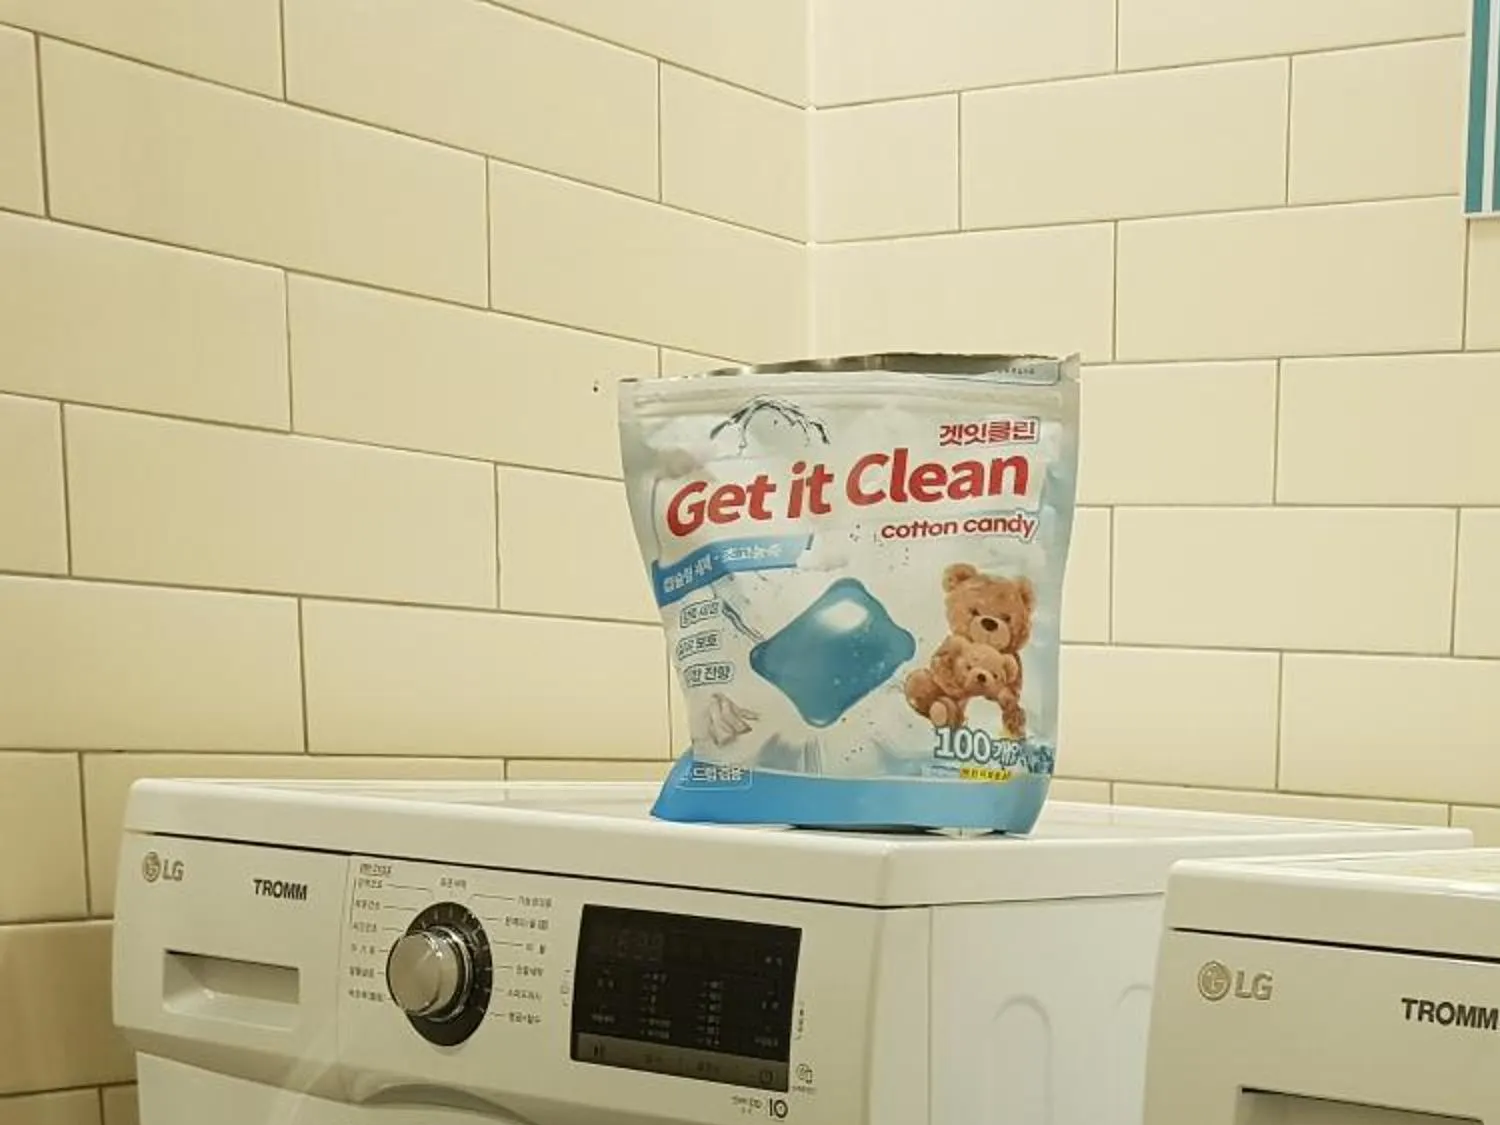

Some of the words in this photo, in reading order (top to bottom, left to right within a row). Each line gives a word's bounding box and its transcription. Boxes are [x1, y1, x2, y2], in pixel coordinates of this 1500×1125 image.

[939, 420, 1036, 447] 겟잇클린
[665, 474, 776, 537] Get
[787, 460, 835, 519] it
[846, 447, 1030, 507] Clean
[881, 518, 958, 540] cotton
[964, 513, 1038, 540] candy
[253, 878, 308, 901] TROMM
[1234, 969, 1274, 1001] LG
[1401, 997, 1499, 1031] TROMM
